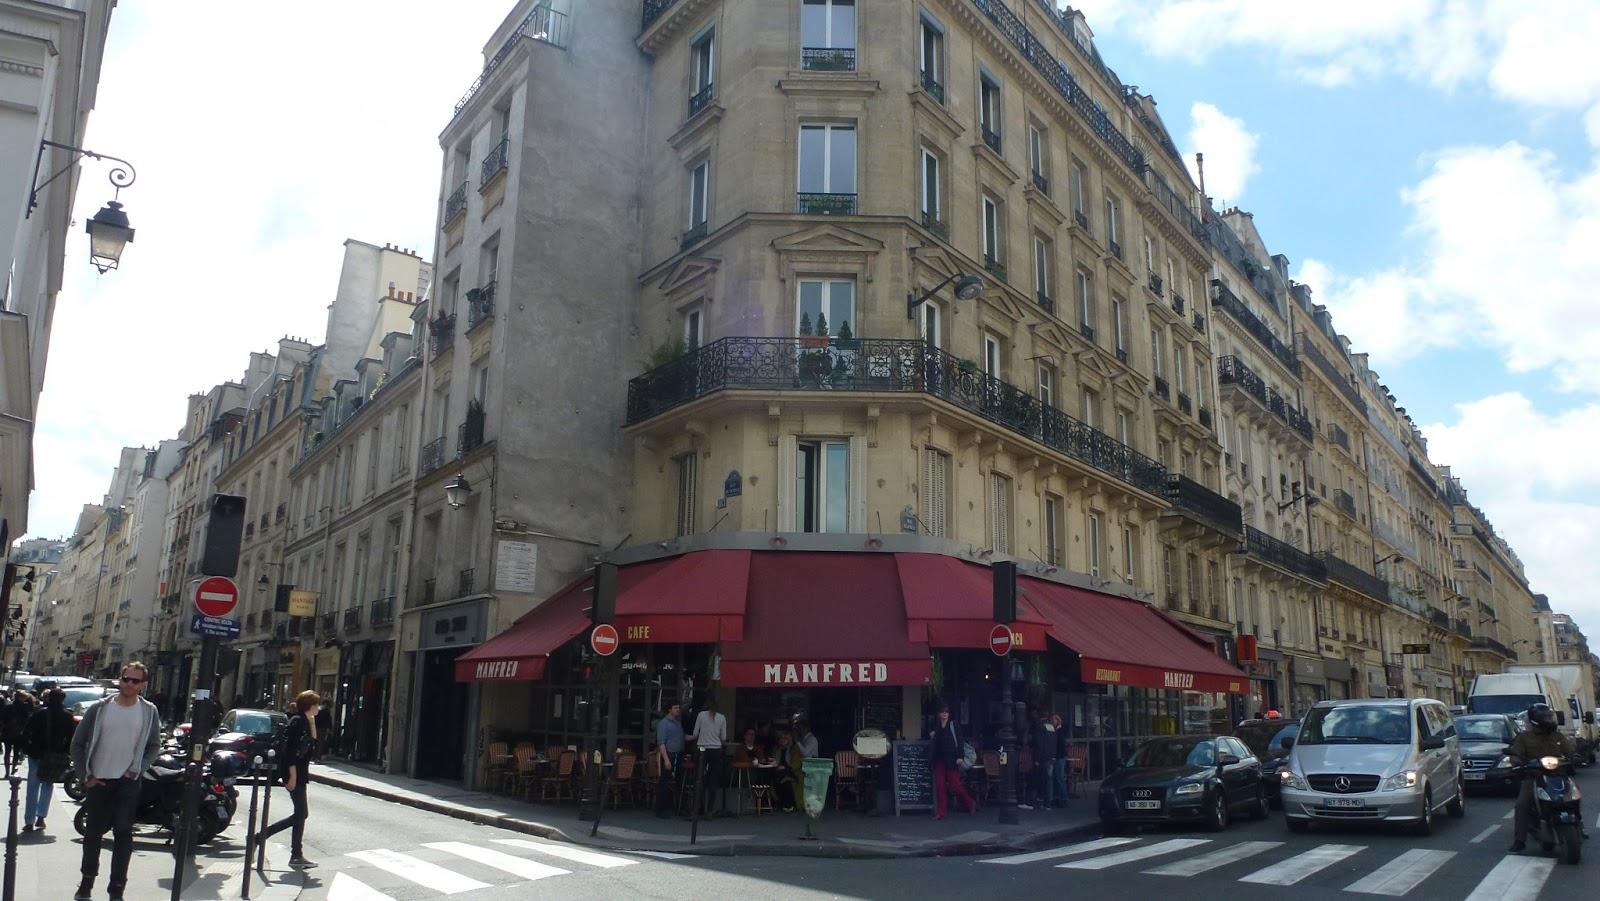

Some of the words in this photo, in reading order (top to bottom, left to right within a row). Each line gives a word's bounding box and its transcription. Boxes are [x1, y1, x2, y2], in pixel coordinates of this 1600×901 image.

[627, 625, 651, 640] CAFE
[475, 661, 519, 679] MANFRED
[764, 662, 888, 684] MANFRED
[1164, 671, 1194, 689] MANFRED
